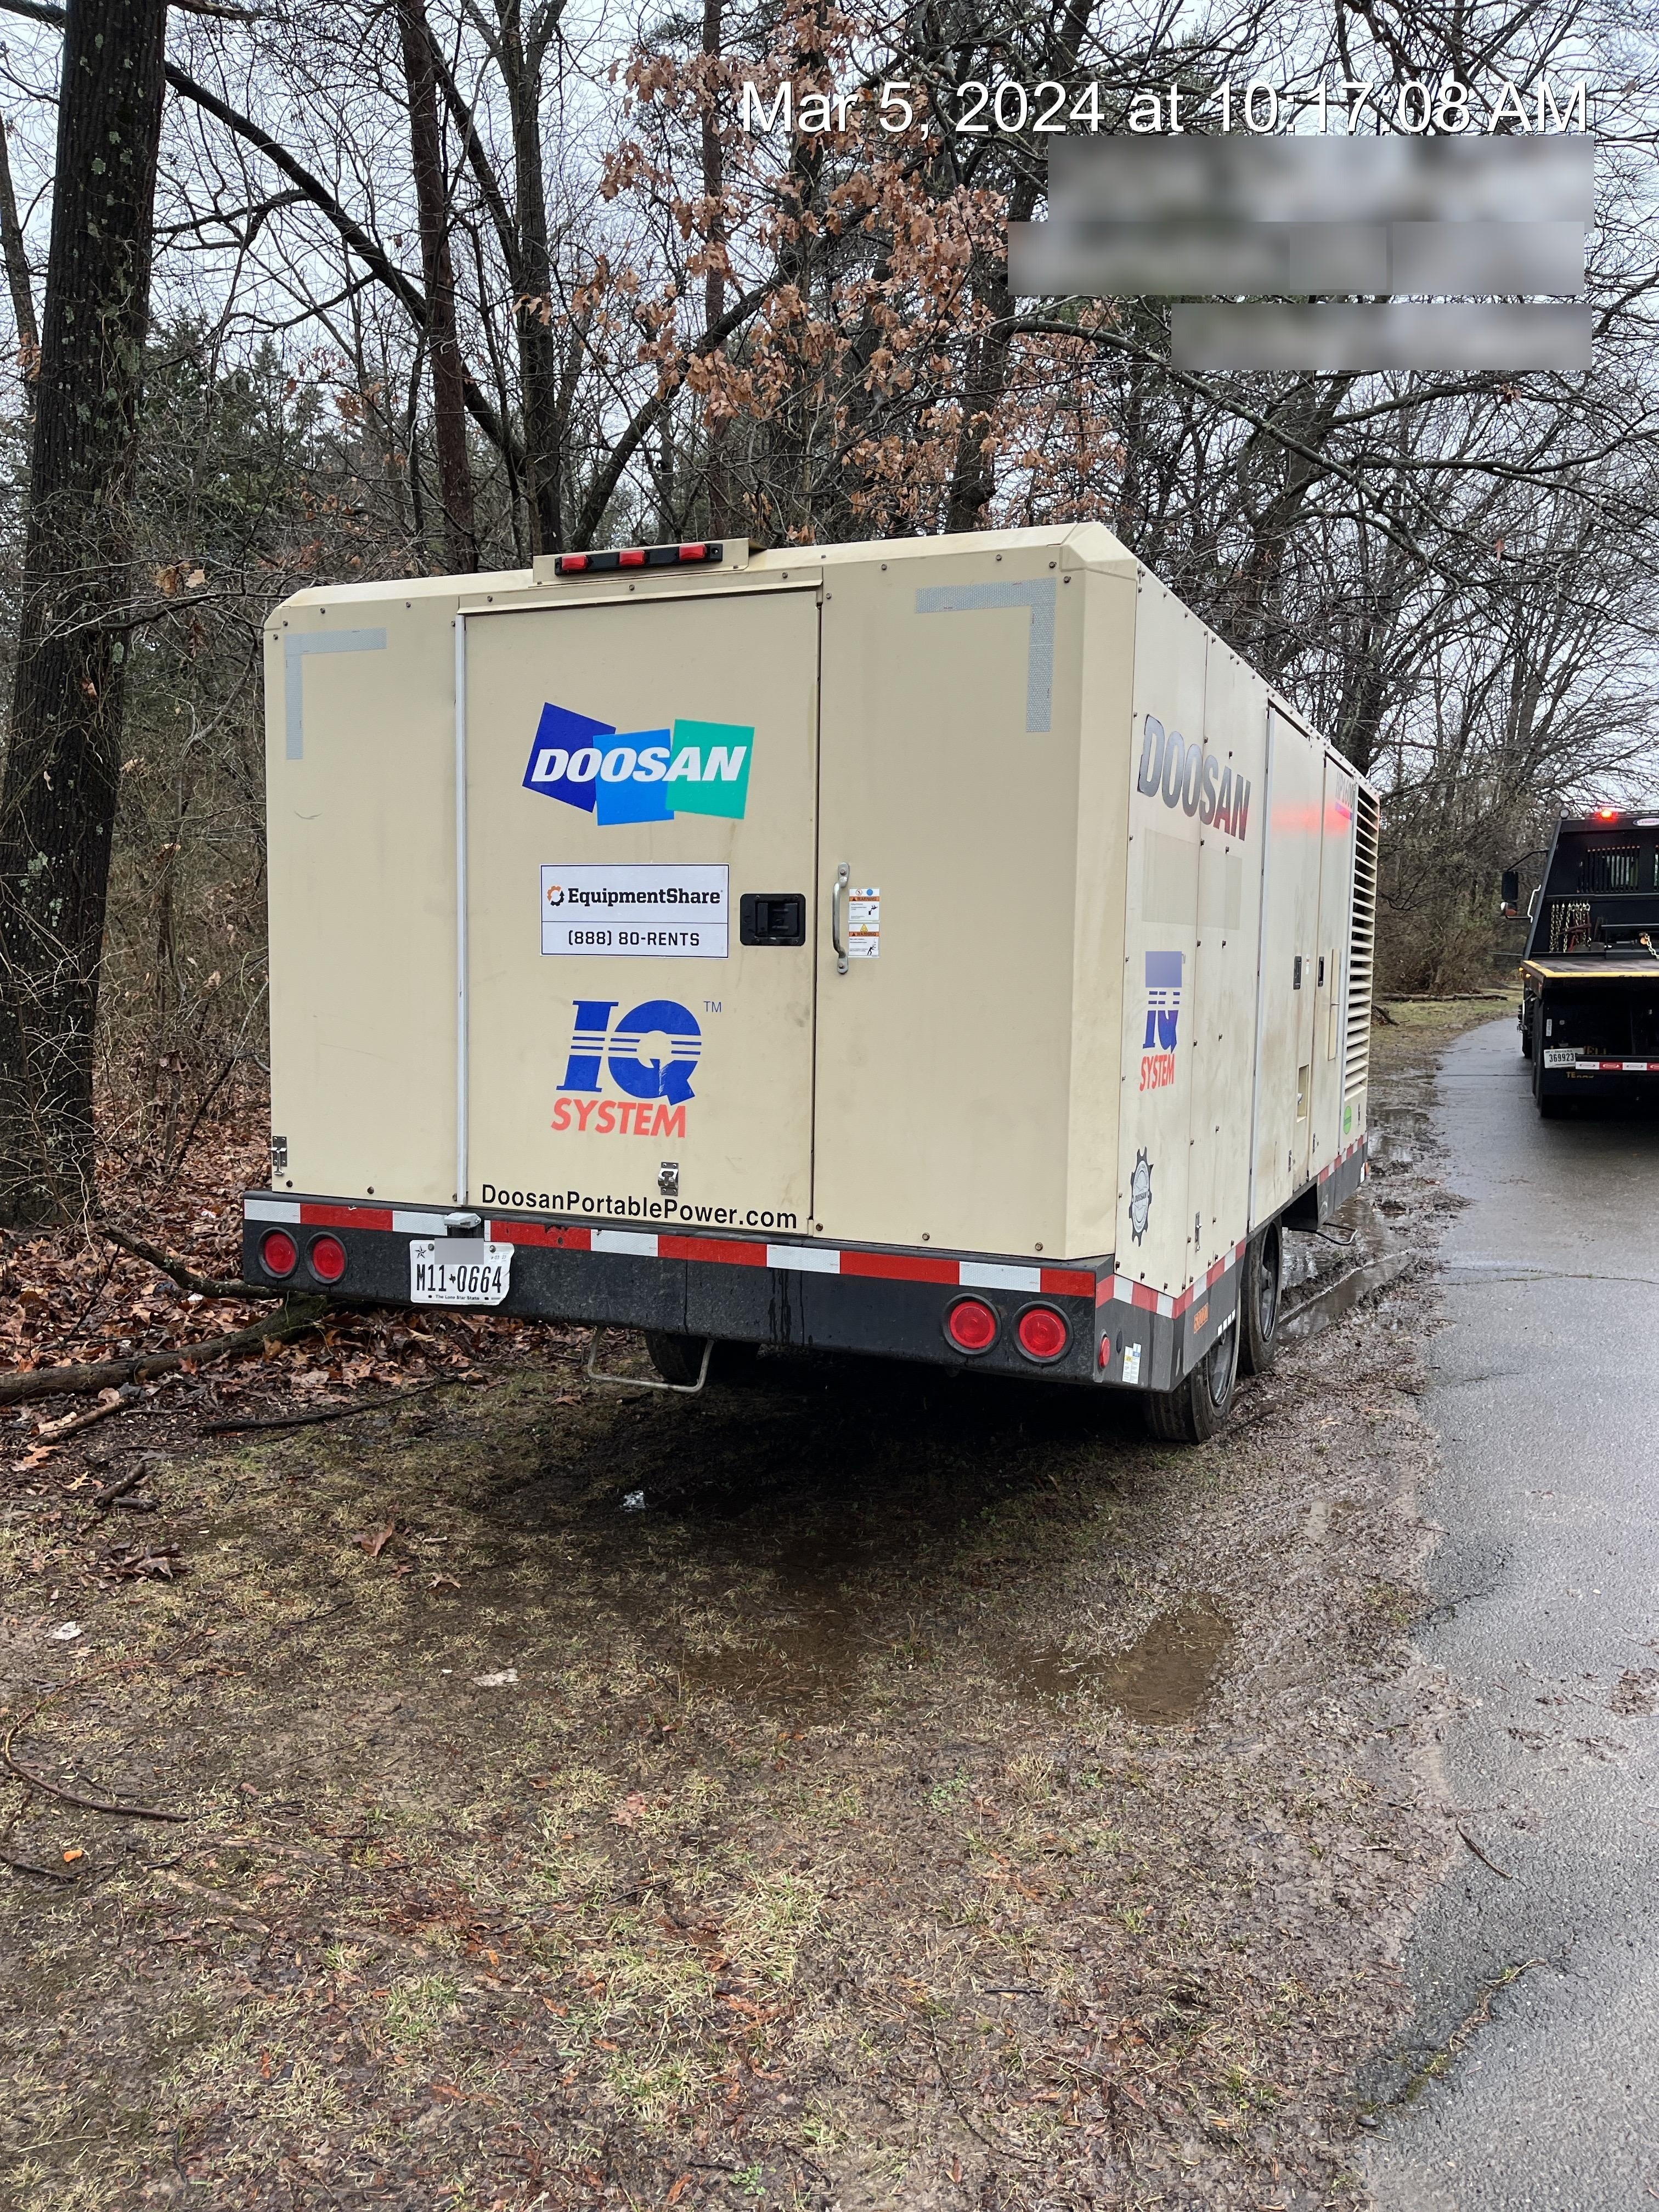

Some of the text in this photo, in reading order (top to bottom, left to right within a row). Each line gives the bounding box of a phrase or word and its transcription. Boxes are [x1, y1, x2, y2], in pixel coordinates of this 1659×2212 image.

[531, 746, 747, 782] DOOSAN
[1137, 714, 1251, 841] DOOSAN
[568, 888, 720, 907] EquipmentShare
[568, 930, 700, 946] (888) 80-RENTS
[556, 1000, 722, 1106] IQ TM
[1139, 1053, 1175, 1091] SYSTEM
[550, 1097, 686, 1138] SYSTEM
[482, 1184, 797, 1229] DoosanPortablePower.com
